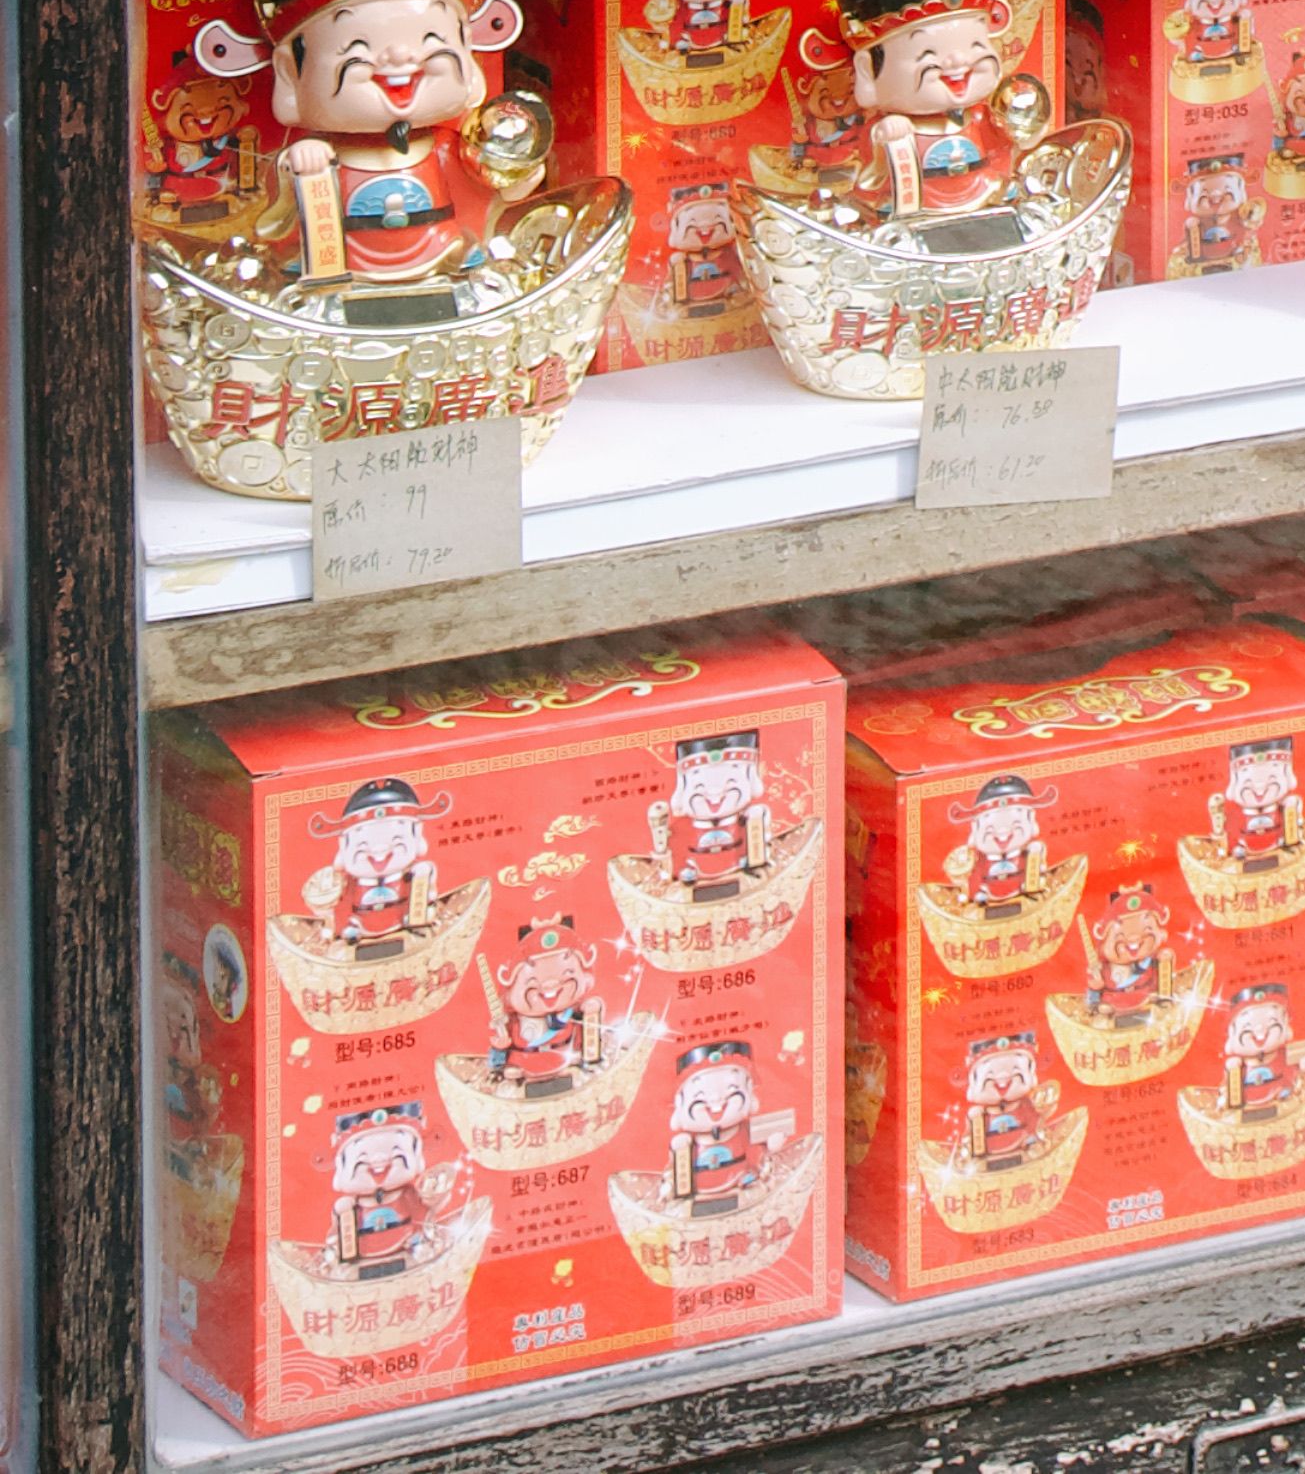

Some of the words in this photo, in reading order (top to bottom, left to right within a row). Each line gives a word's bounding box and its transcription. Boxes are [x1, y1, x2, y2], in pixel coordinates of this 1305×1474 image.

[677, 967, 757, 1000] 型号:686
[335, 1030, 416, 1064] 型号:685
[510, 1164, 591, 1199] 型号:687
